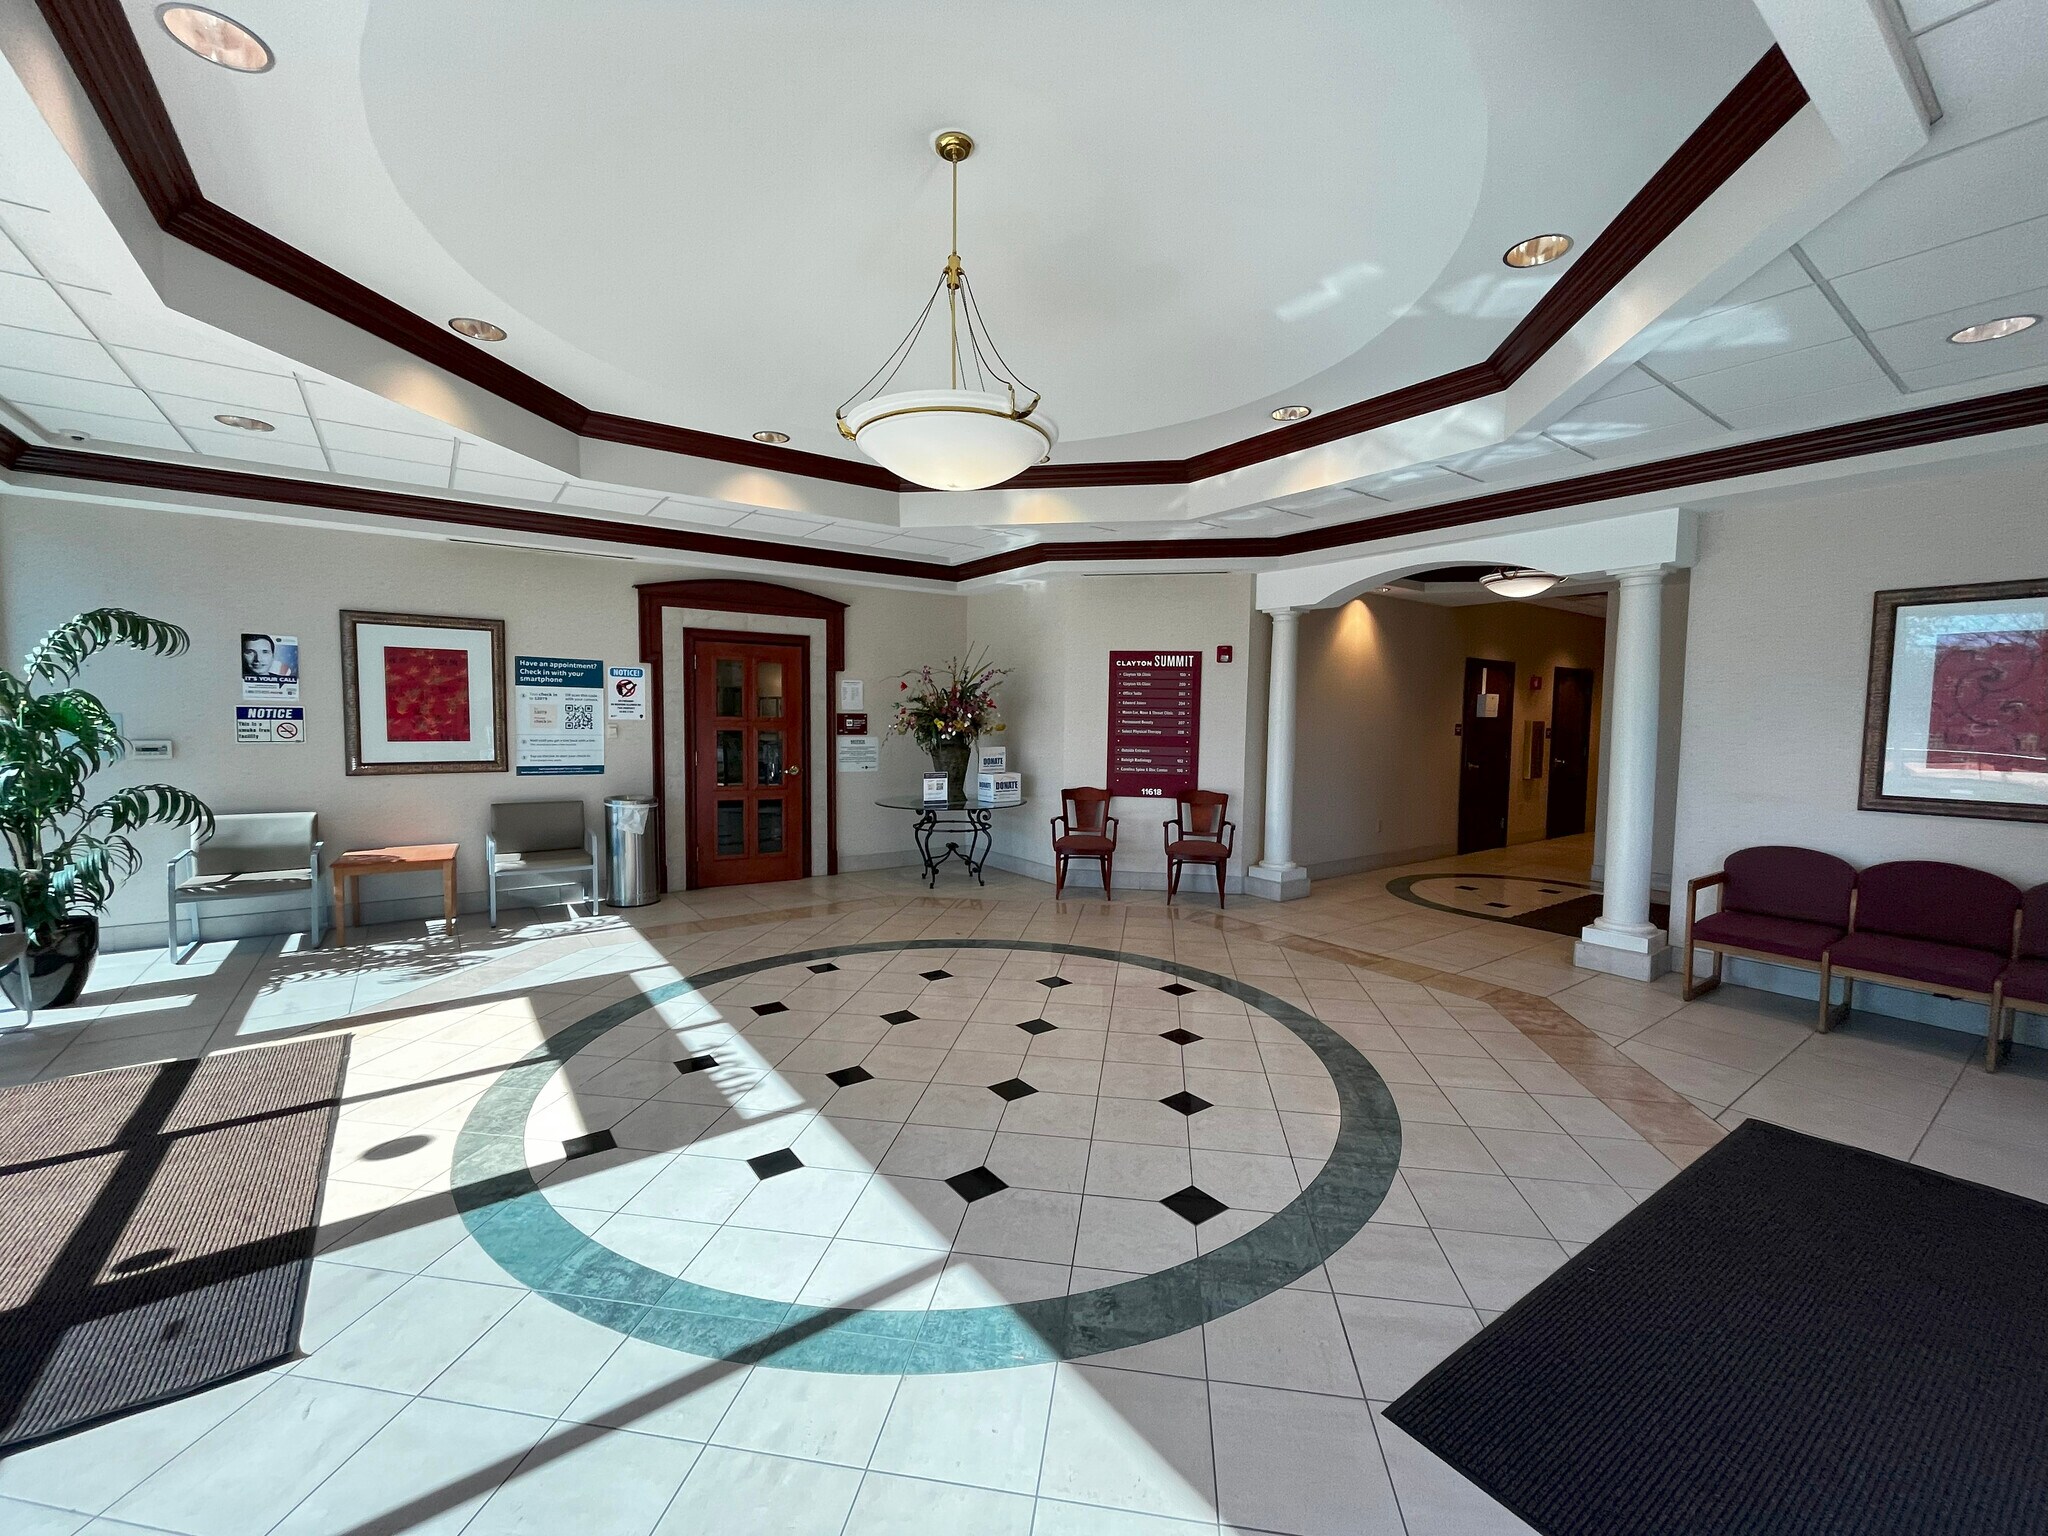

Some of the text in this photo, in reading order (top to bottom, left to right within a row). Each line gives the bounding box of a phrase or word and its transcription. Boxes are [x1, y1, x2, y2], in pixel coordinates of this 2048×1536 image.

[1154, 655, 1194, 667] SUMMIT
[248, 708, 293, 718] NOTICE
[995, 781, 1018, 790] DONATE
